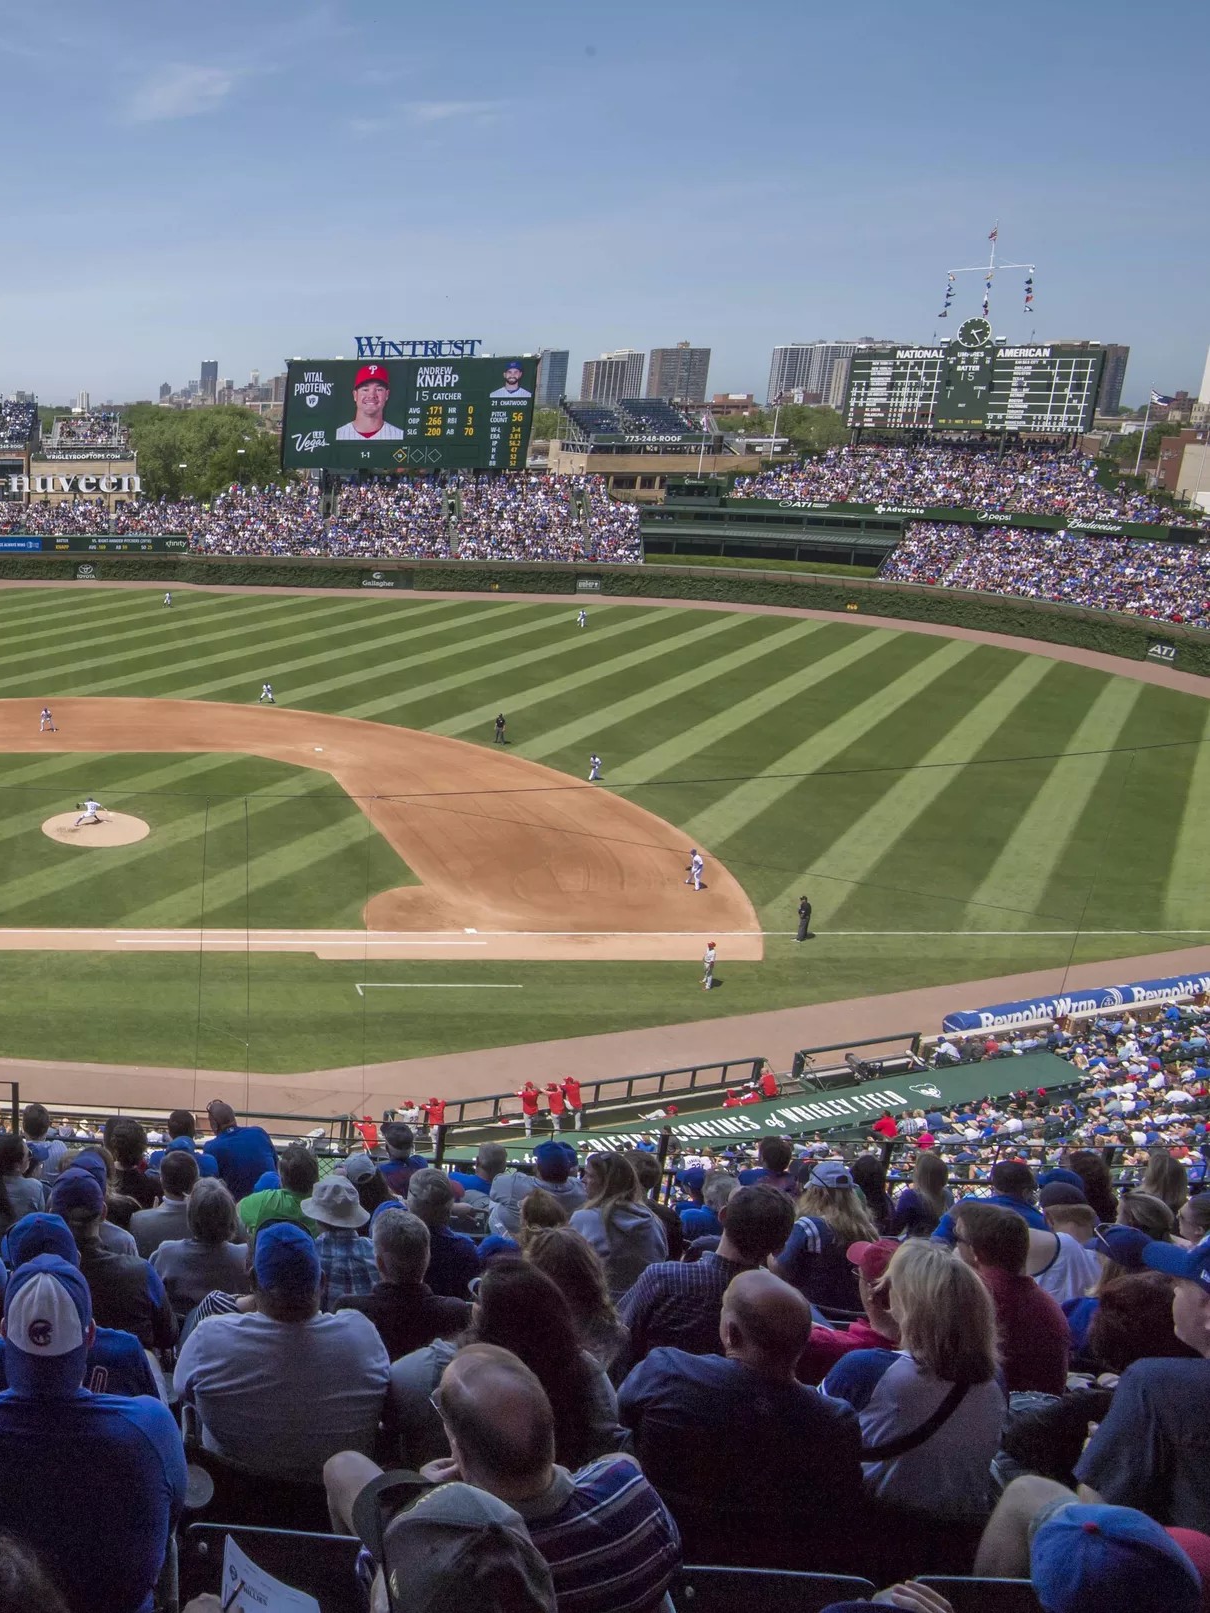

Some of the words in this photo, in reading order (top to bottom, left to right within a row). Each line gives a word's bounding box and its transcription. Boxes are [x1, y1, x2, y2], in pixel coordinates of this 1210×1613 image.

[354, 336, 482, 358] WINTRUST
[896, 349, 945, 359] NATIONAL
[996, 348, 1051, 358] AMERICAN
[418, 366, 453, 375] ANDREW
[304, 372, 324, 382] VITAL
[416, 374, 460, 388] KNAPP
[960, 372, 975, 381] 15
[294, 382, 332, 396] PROTEINS
[416, 391, 430, 401] 15
[426, 406, 442, 415] .171
[468, 406, 474, 414] 0
[426, 417, 442, 425] .266
[512, 412, 523, 422] 56
[425, 428, 441, 436] .200
[291, 432, 330, 452] Vegas
[8, 473, 142, 493] nuveen
[988, 514, 1012, 522] pepsi
[1067, 518, 1122, 531] Budweiser
[1149, 644, 1175, 657] ATI
[980, 1004, 1052, 1026] Reynolds
[1053, 998, 1096, 1018] Wrap
[764, 1111, 786, 1129] of
[777, 1096, 856, 1123] WRIGLEY
[850, 1090, 908, 1112] FIELD
